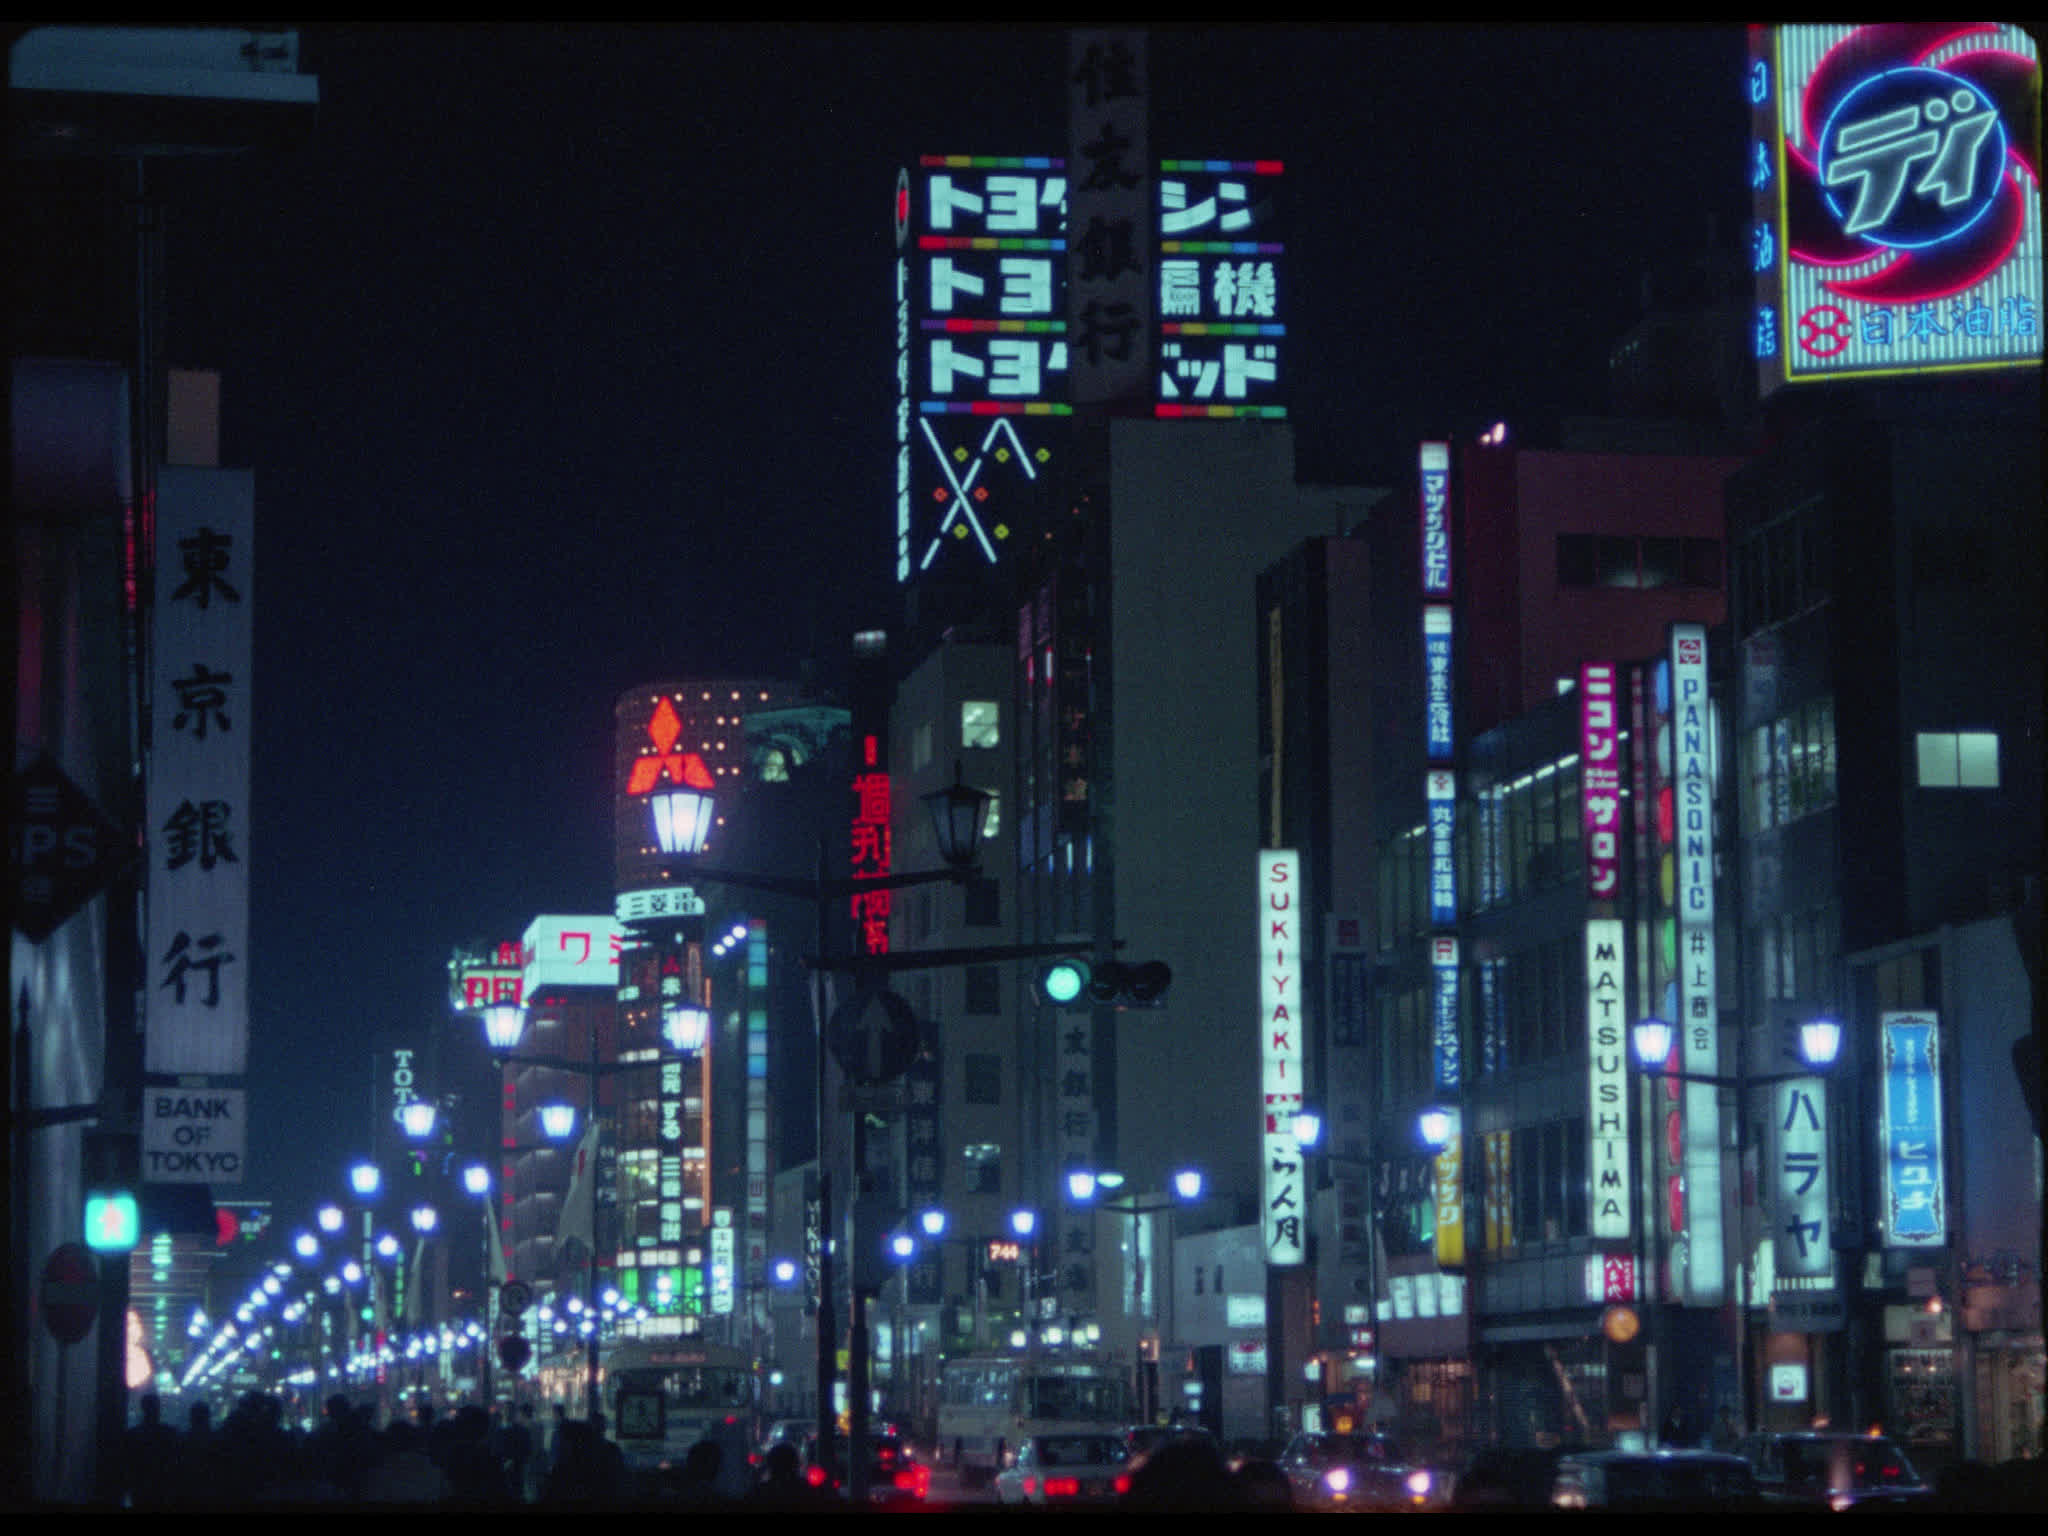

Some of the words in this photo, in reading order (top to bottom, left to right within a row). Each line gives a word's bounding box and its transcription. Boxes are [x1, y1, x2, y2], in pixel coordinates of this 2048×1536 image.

[1860, 294, 2038, 346] 日本油脂
[162, 527, 240, 1007] 東京銀行
[1682, 679, 1705, 911] PANASONIC
[1270, 862, 1291, 1079] SUKIYAKI
[1690, 932, 1710, 1052] 井上商会
[155, 1097, 231, 1119] BANK
[174, 1126, 212, 1146] OF
[1594, 943, 1622, 1217] MATSUSHIMA
[148, 1151, 241, 1173] TOKYO
